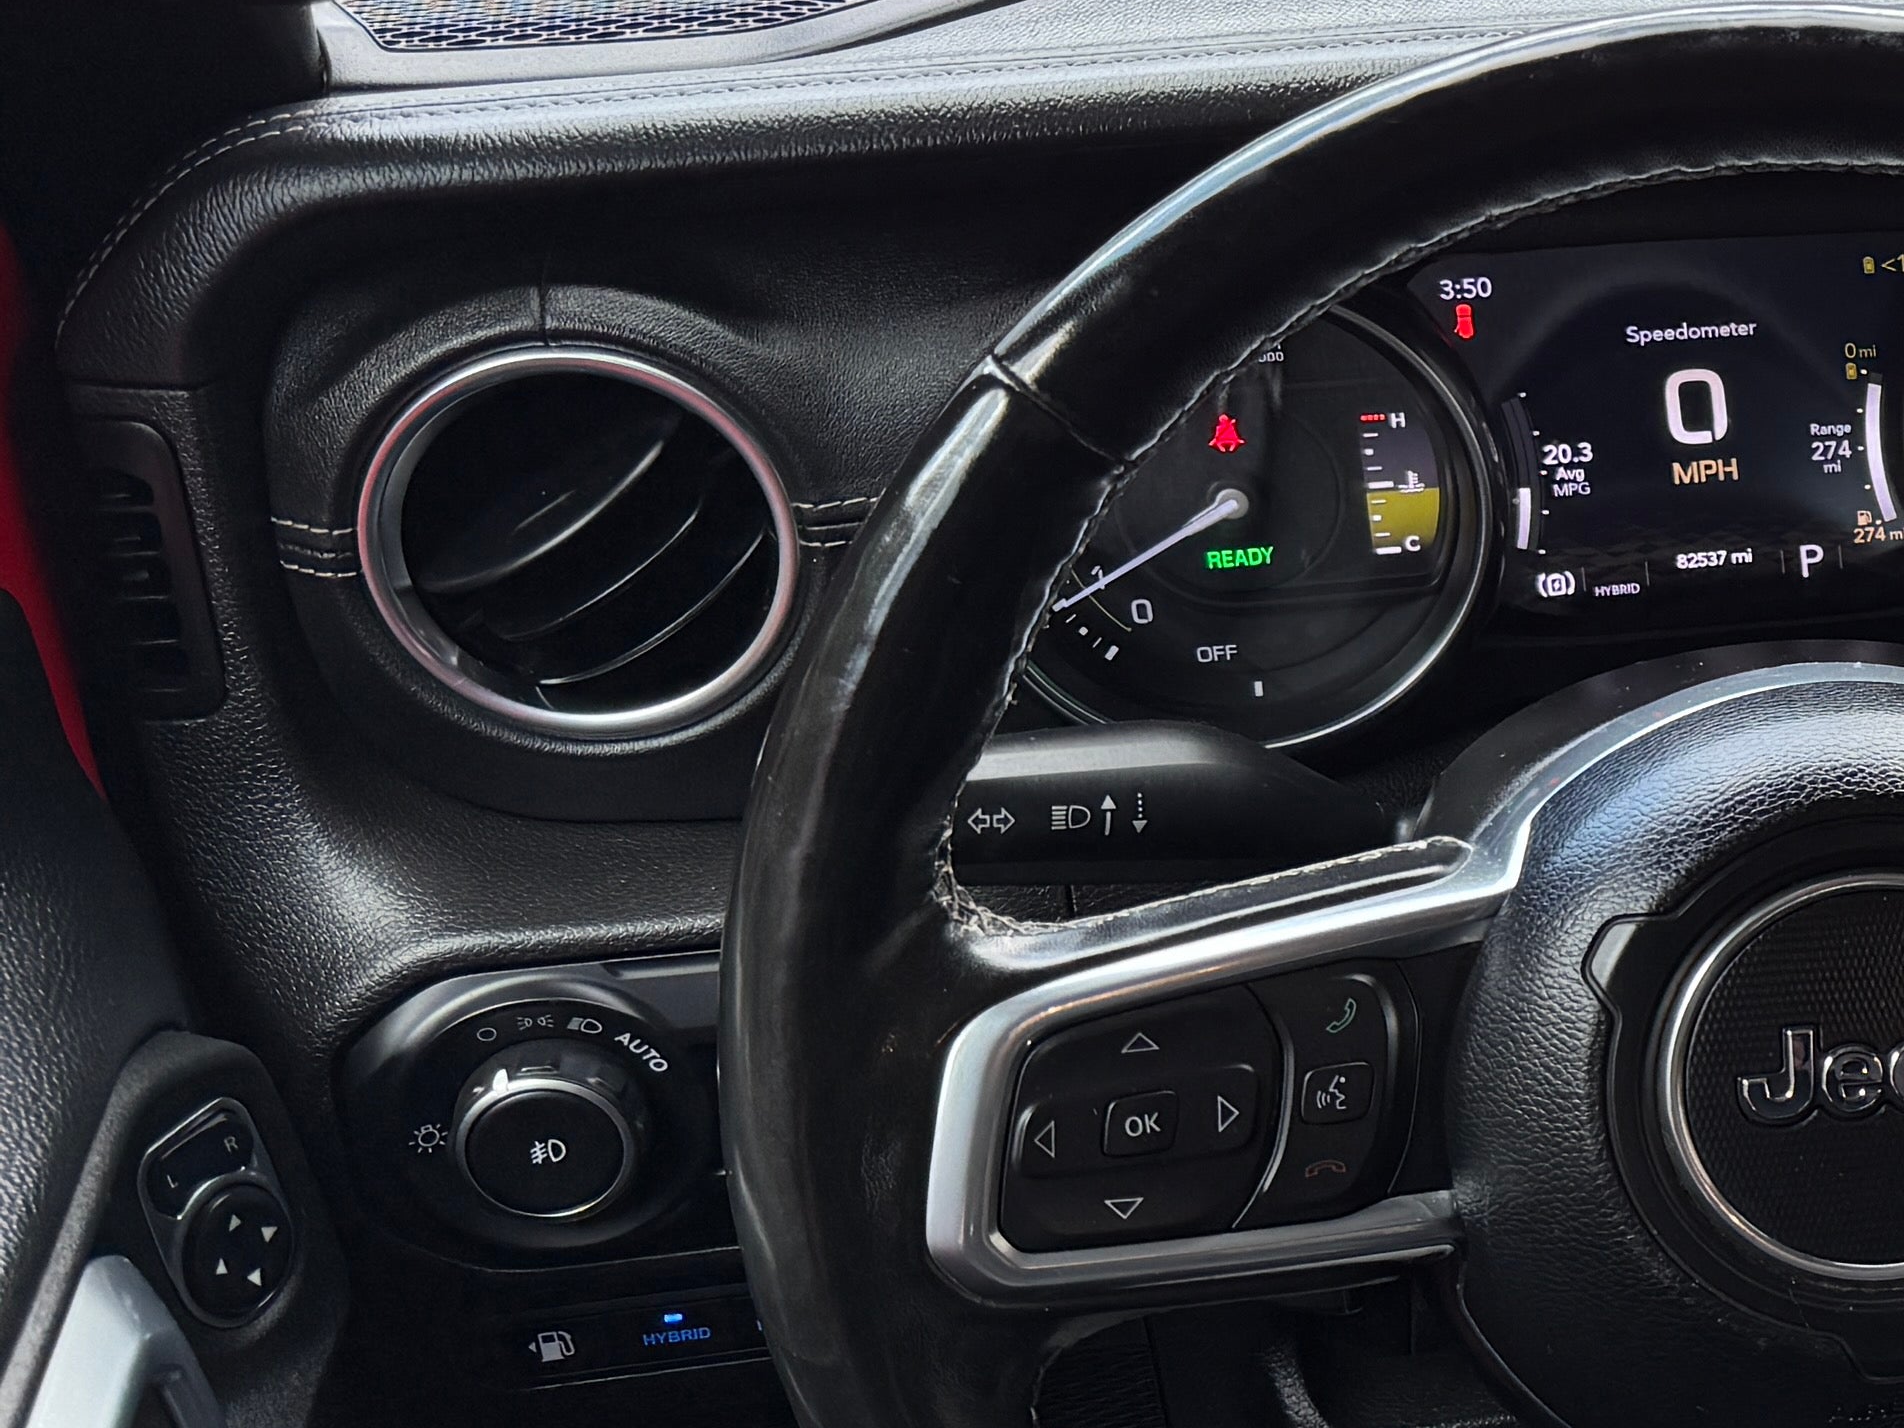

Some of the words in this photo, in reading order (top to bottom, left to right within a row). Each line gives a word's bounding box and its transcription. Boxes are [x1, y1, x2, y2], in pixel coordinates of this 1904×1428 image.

[1439, 277, 1493, 301] 3:50
[1625, 320, 1758, 347] Speedometer
[1844, 342, 1857, 359] 0
[1858, 343, 1877, 358] mi
[1663, 368, 1728, 445] 0
[1389, 412, 1406, 428] H
[1809, 422, 1852, 438] Range
[1542, 442, 1594, 464] 20.3
[1811, 440, 1852, 461] 274
[1554, 466, 1585, 483] Avg
[1671, 457, 1739, 486] MPH
[1823, 459, 1842, 473] mi
[1552, 481, 1592, 498] MPG
[1853, 527, 1886, 543] 274
[1207, 546, 1274, 569] READY
[1676, 550, 1728, 569] 82537
[1730, 547, 1753, 565] mi
[1800, 543, 1825, 578] P
[1593, 582, 1641, 597] HYBRID
[1131, 599, 1153, 624] 0
[1196, 644, 1238, 663] OFF
[614, 1031, 669, 1073] AUTO
[1124, 1111, 1161, 1137] OK
[223, 1133, 238, 1154] R
[642, 1326, 712, 1347] HYBRID
